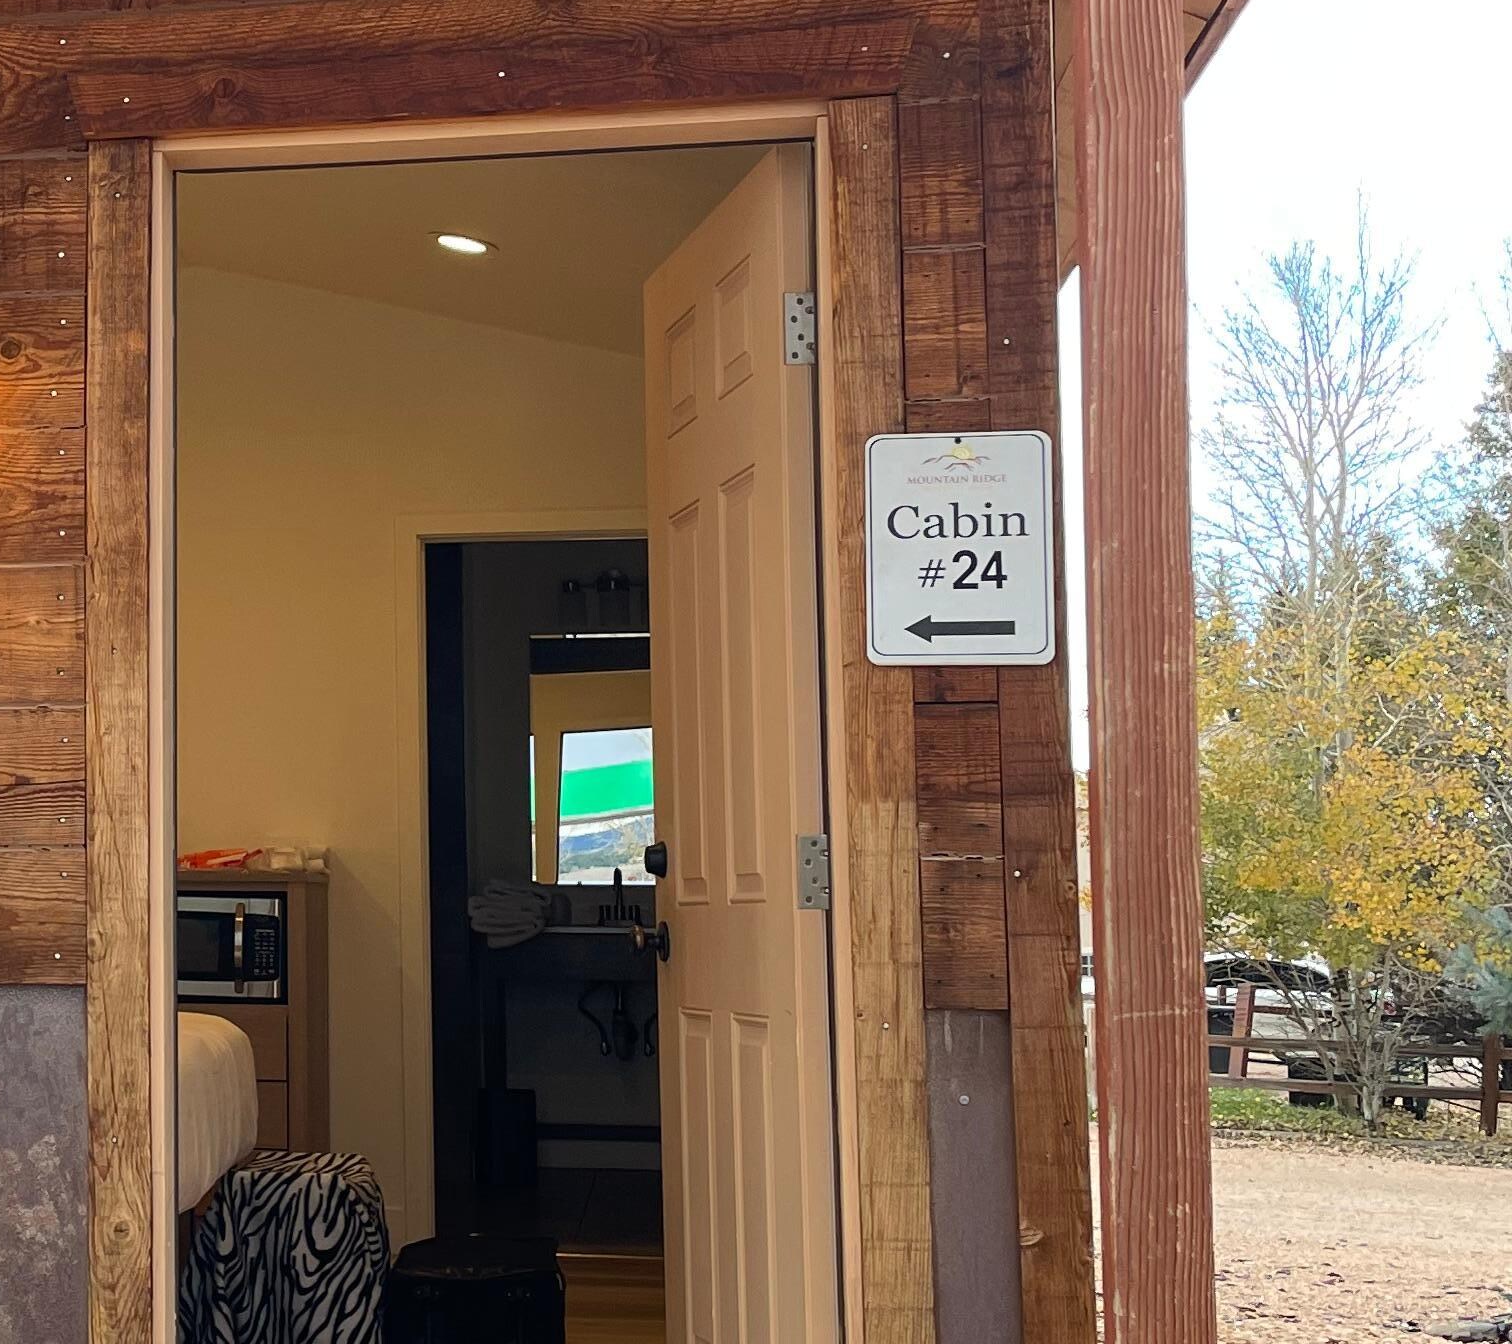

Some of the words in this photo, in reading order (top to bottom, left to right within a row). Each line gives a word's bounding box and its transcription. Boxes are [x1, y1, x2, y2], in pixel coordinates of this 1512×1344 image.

[906, 475, 969, 485] MOUNTAIN
[972, 474, 1007, 483] RIDGE
[887, 502, 1030, 539] Cabin
[917, 549, 1008, 589] #24
